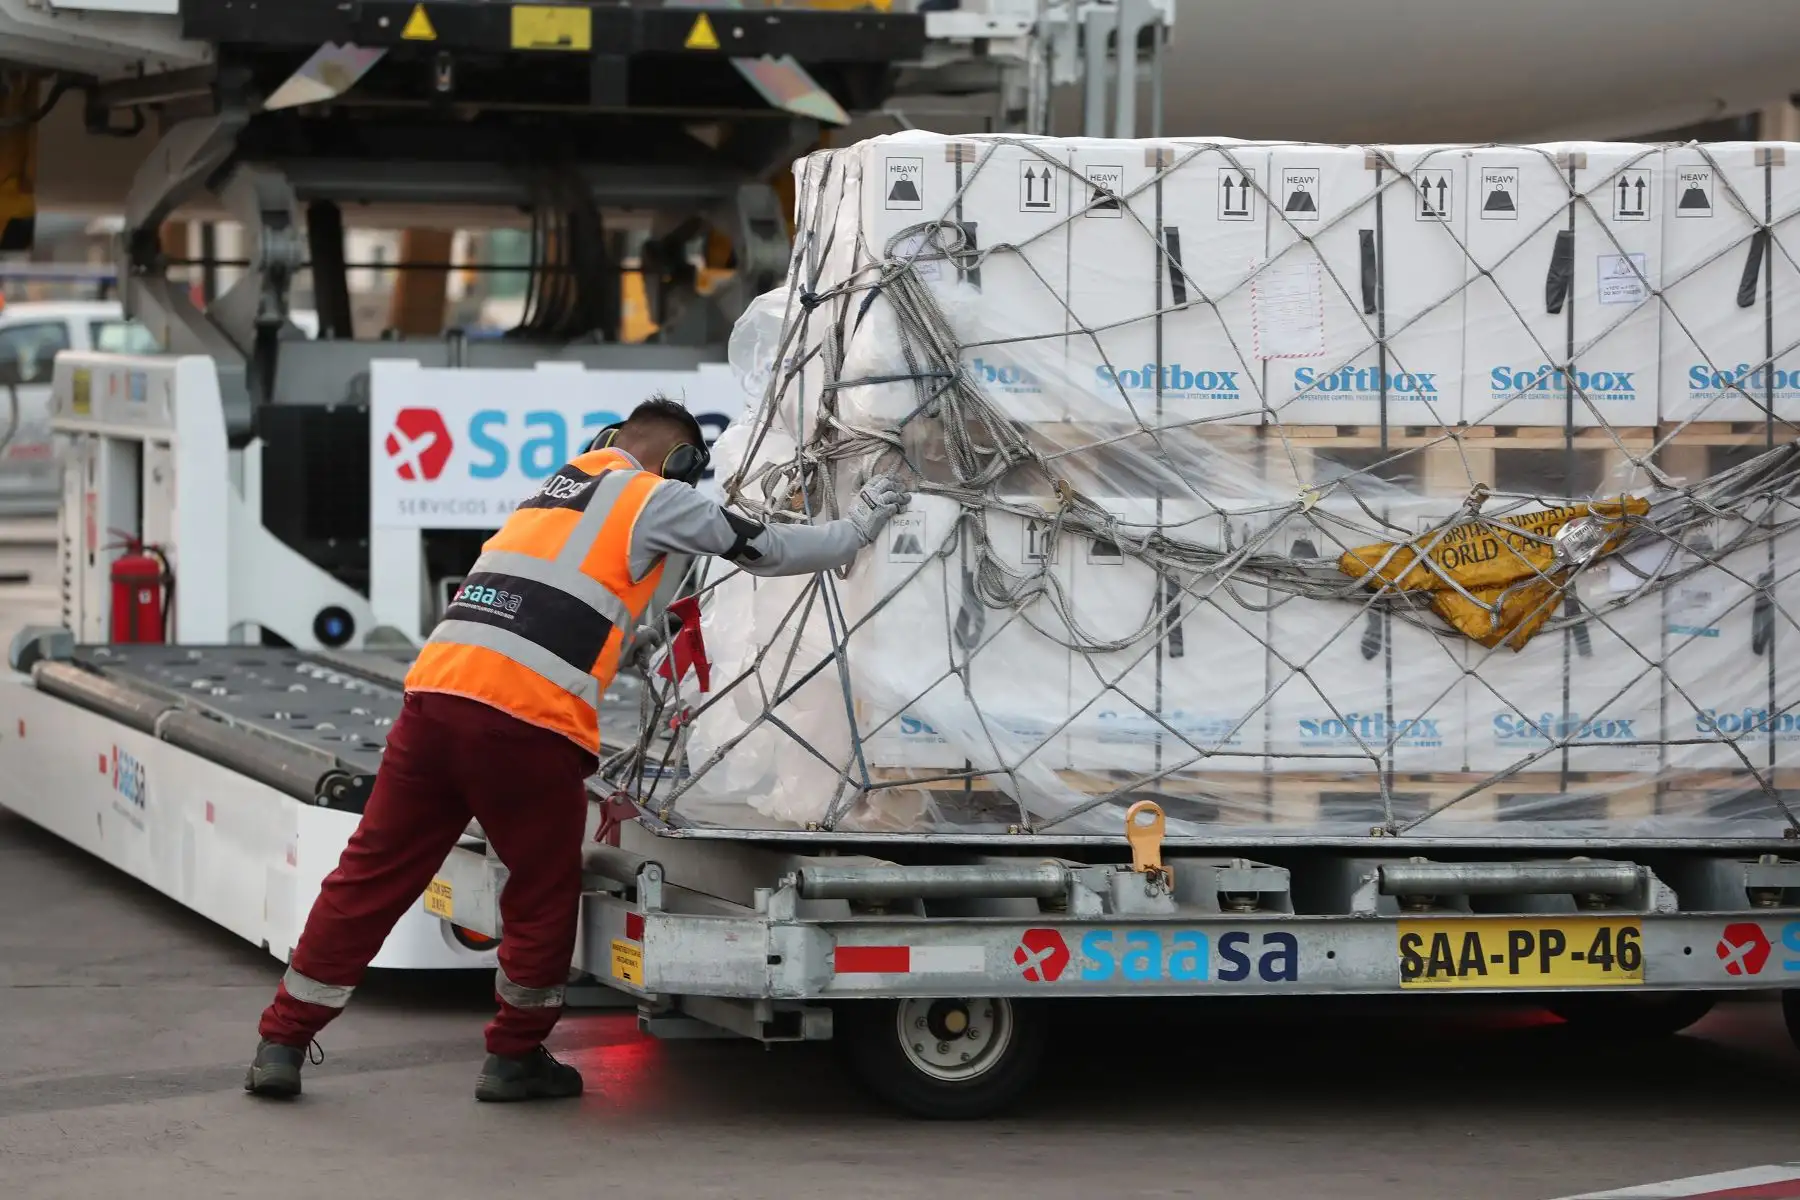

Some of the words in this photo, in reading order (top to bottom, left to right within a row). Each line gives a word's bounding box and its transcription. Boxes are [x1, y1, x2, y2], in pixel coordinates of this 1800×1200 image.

[1286, 176, 1315, 184] HEAVY
[1485, 175, 1514, 183] HEAVY
[1680, 173, 1709, 181] HEAVY
[1095, 363, 1240, 391] Softbox
[1294, 366, 1438, 392] Softbox
[1491, 364, 1635, 391] Softbox
[460, 584, 522, 613] saasa
[1081, 930, 1299, 982] saasa
[1399, 926, 1642, 982] SAA-PP-46
